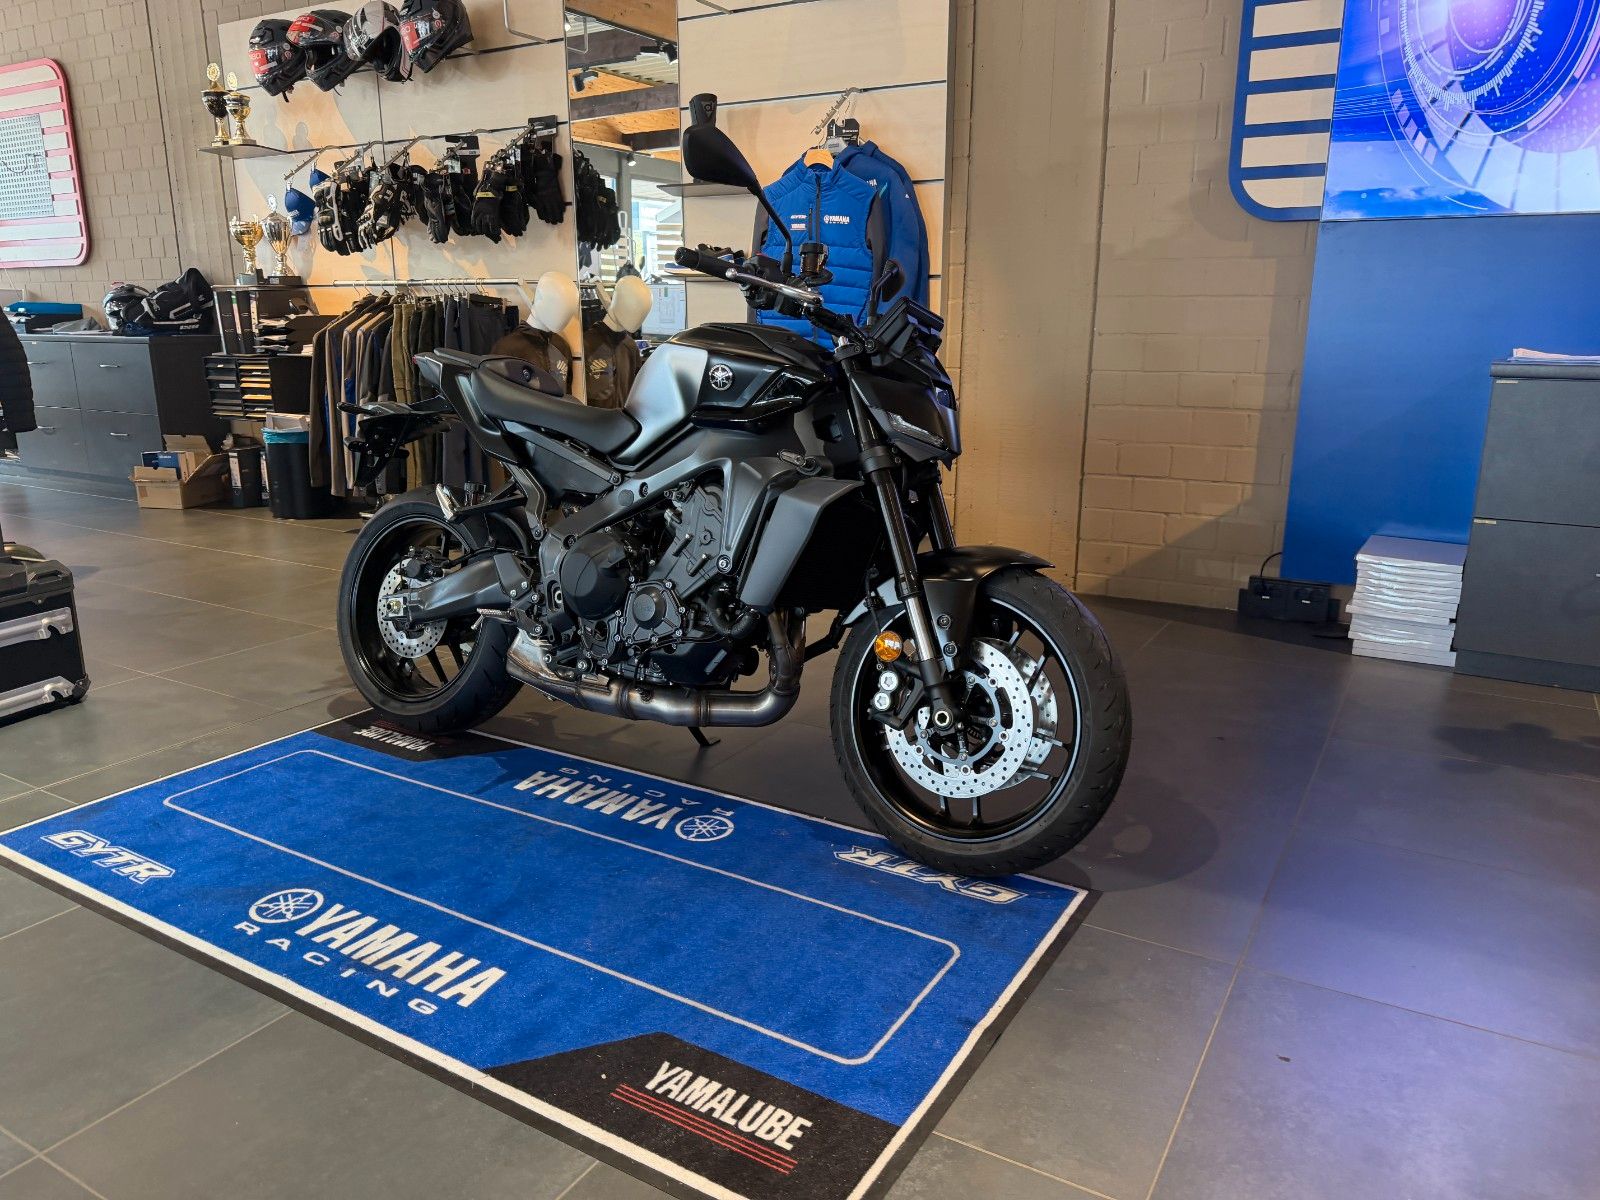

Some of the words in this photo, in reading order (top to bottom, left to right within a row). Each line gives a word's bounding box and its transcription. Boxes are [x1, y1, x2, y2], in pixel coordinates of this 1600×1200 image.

[513, 770, 684, 830] YAMAHA
[558, 766, 736, 818] RACING
[40, 829, 176, 885] GYTR
[233, 920, 439, 1016] RACING
[294, 903, 508, 1009] YAMAHA
[644, 1060, 814, 1151] YAMALUBE
